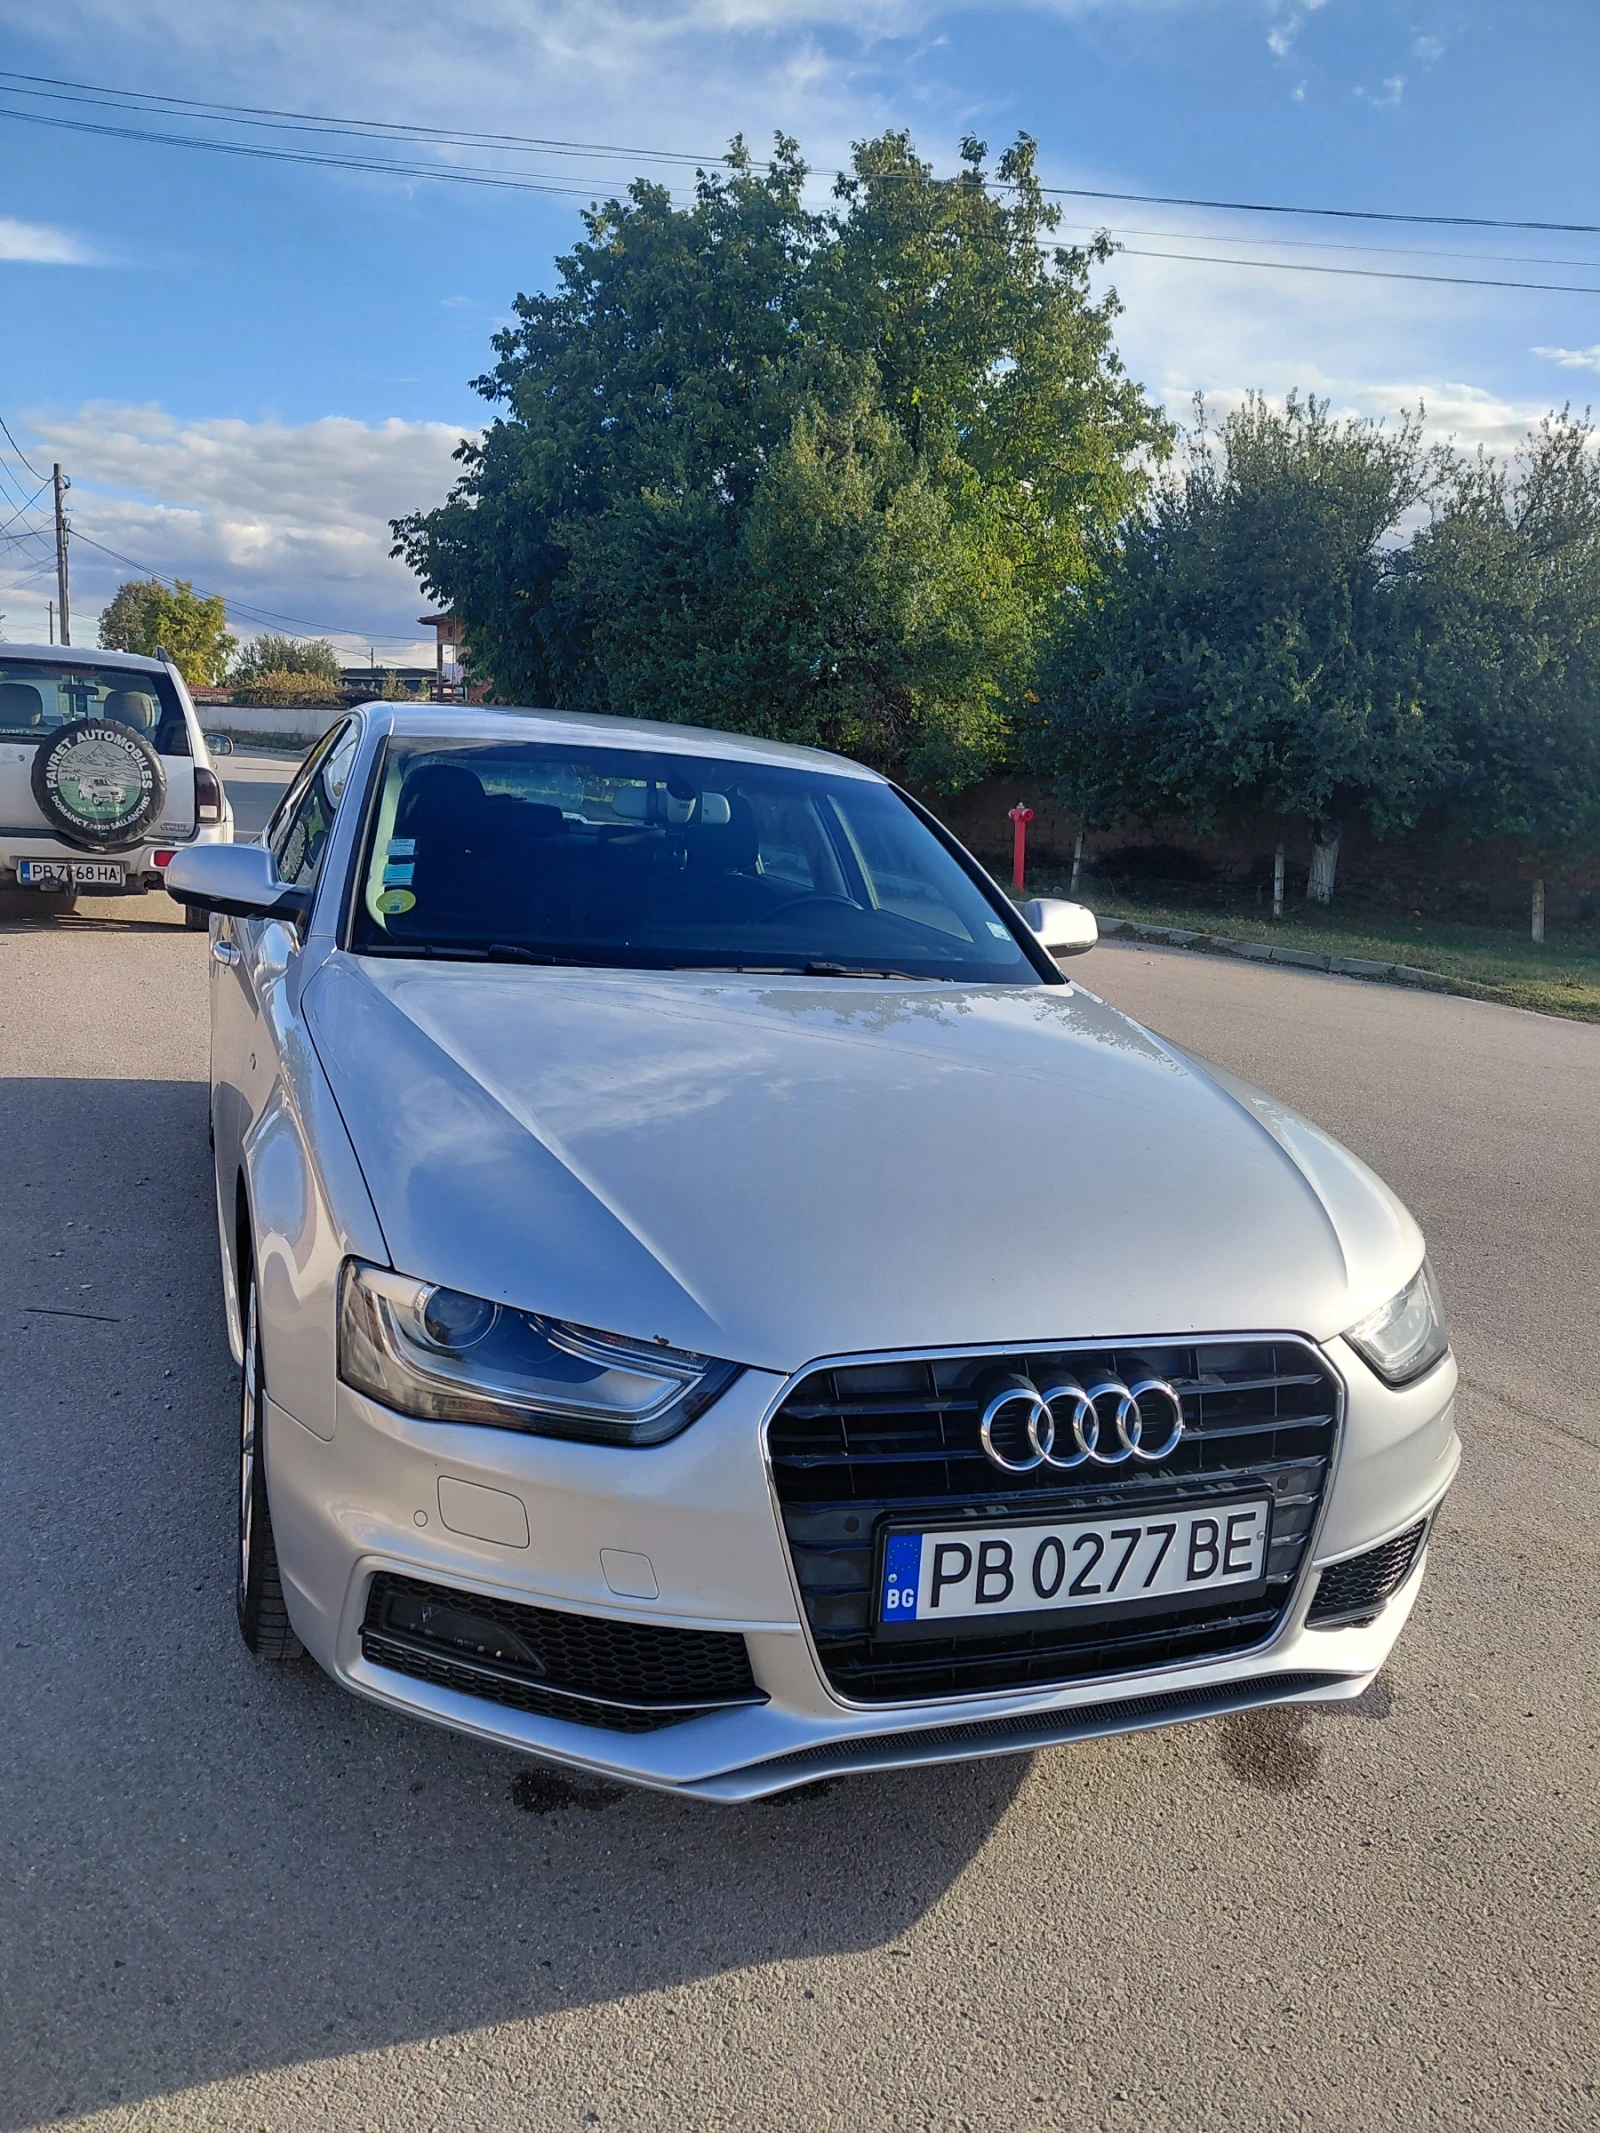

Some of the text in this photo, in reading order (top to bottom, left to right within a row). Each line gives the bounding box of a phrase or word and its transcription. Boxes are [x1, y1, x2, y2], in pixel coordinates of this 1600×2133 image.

[46, 729, 153, 789] FAVRET AUTOMOBILES
[51, 795, 89, 827] DOMANCY
[110, 795, 151, 830] SALLANCHES
[56, 865, 94, 880] 768
[97, 866, 118, 881] HA
[930, 1511, 1258, 1609] PB 0277 BE
[886, 1588, 915, 1610] BG
